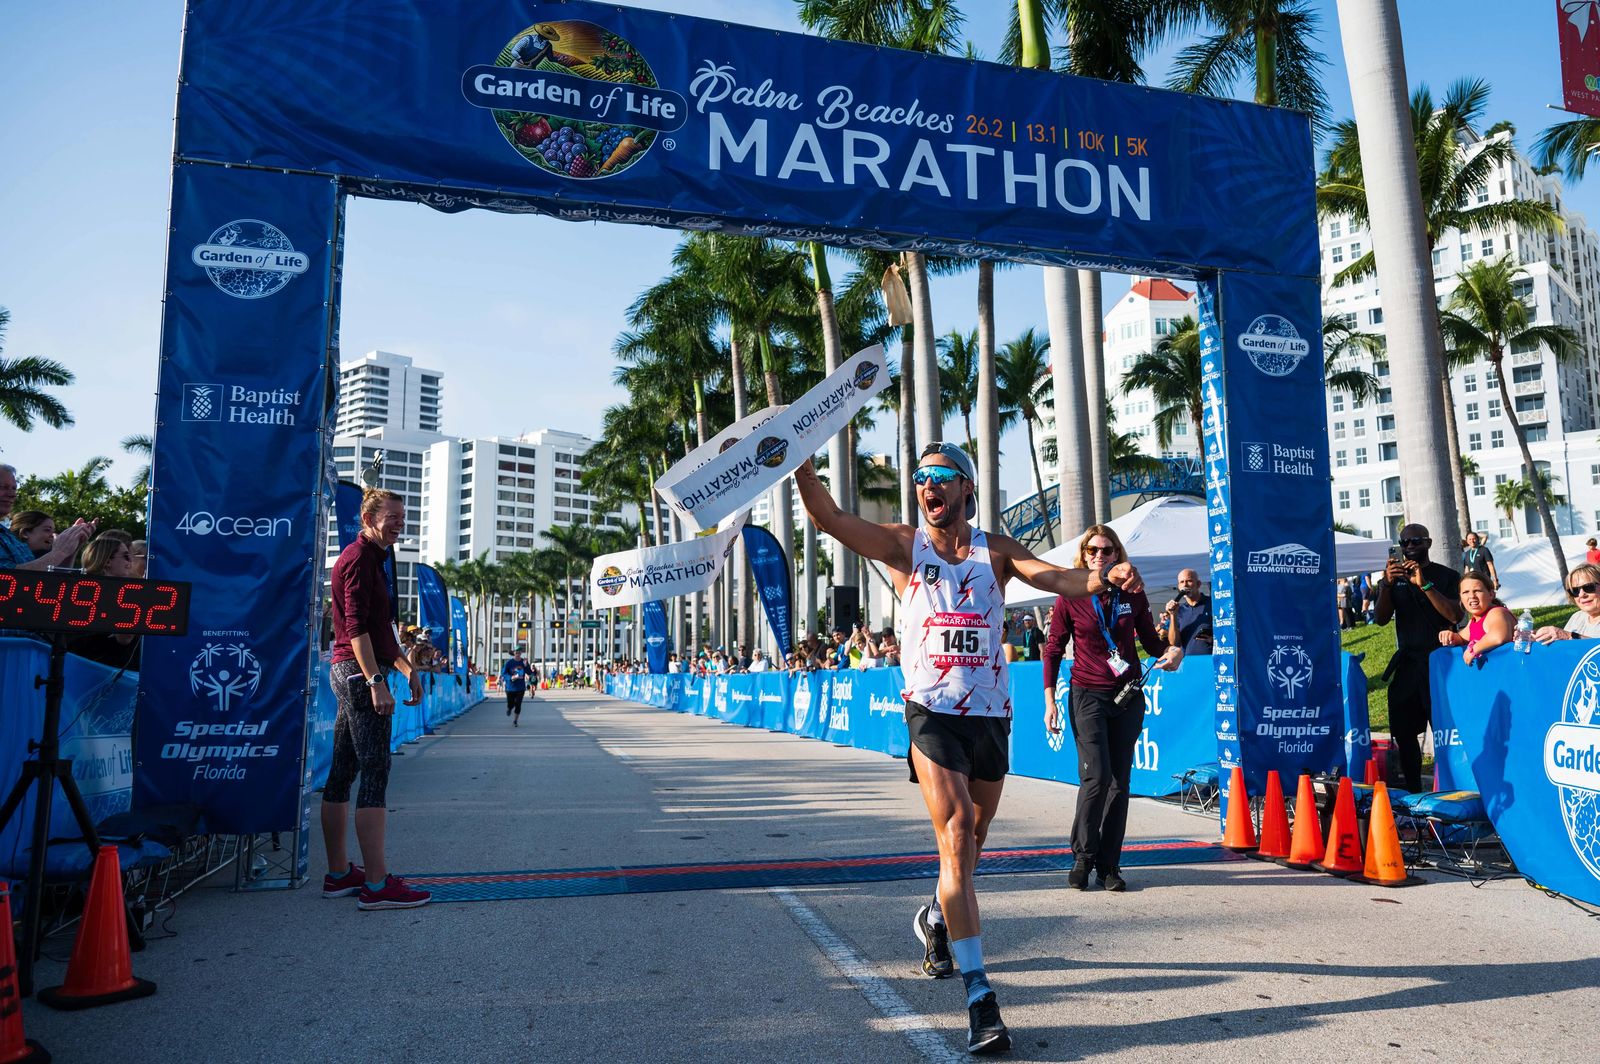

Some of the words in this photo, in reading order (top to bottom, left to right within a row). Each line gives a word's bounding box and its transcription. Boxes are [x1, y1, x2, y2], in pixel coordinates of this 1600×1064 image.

[474, 73, 581, 107] Garden
[590, 87, 623, 118] of
[626, 92, 676, 119] Life
[689, 59, 803, 114] Palm
[816, 85, 954, 134] Beaches
[1570, 90, 1589, 99] WEST
[966, 114, 1003, 138] 26.2
[1026, 123, 1056, 144] 13.1
[1078, 131, 1105, 152] 10K
[1127, 137, 1148, 157] 5K
[709, 111, 1151, 221] MARATHON
[199, 249, 252, 264] Garden
[255, 253, 273, 268] of
[275, 255, 302, 267] Life
[1242, 337, 1277, 349] Garden
[1277, 340, 1288, 352] of
[1290, 342, 1306, 351] Life
[230, 385, 301, 408] Baptist
[229, 406, 296, 426] Health
[792, 378, 852, 435] MARATHON
[770, 440, 788, 455] Garden
[1272, 443, 1315, 462] Baptist
[1274, 460, 1314, 476] Health
[674, 457, 753, 512] MARATHON
[715, 477, 741, 499] Beaches
[646, 562, 675, 575] Beaches
[1249, 553, 1270, 565] ED
[1273, 554, 1320, 567] MORSE
[630, 559, 716, 588] MARATHON
[1247, 566, 1295, 574] AUTOMOTIVE
[1296, 567, 1320, 575] GROUP
[942, 618, 987, 626] MARATHON
[940, 629, 979, 654] 145
[934, 655, 985, 664] MARATHON
[1263, 706, 1320, 720] Special
[174, 720, 270, 739] Special
[1256, 723, 1330, 739] Olympics
[160, 742, 280, 762] Olympics
[1278, 741, 1314, 753] Florida
[1553, 740, 1600, 773] Garde
[107, 743, 117, 786] of
[118, 749, 132, 775] Lif
[193, 763, 247, 780] Florida
[1339, 833, 1354, 860] E
